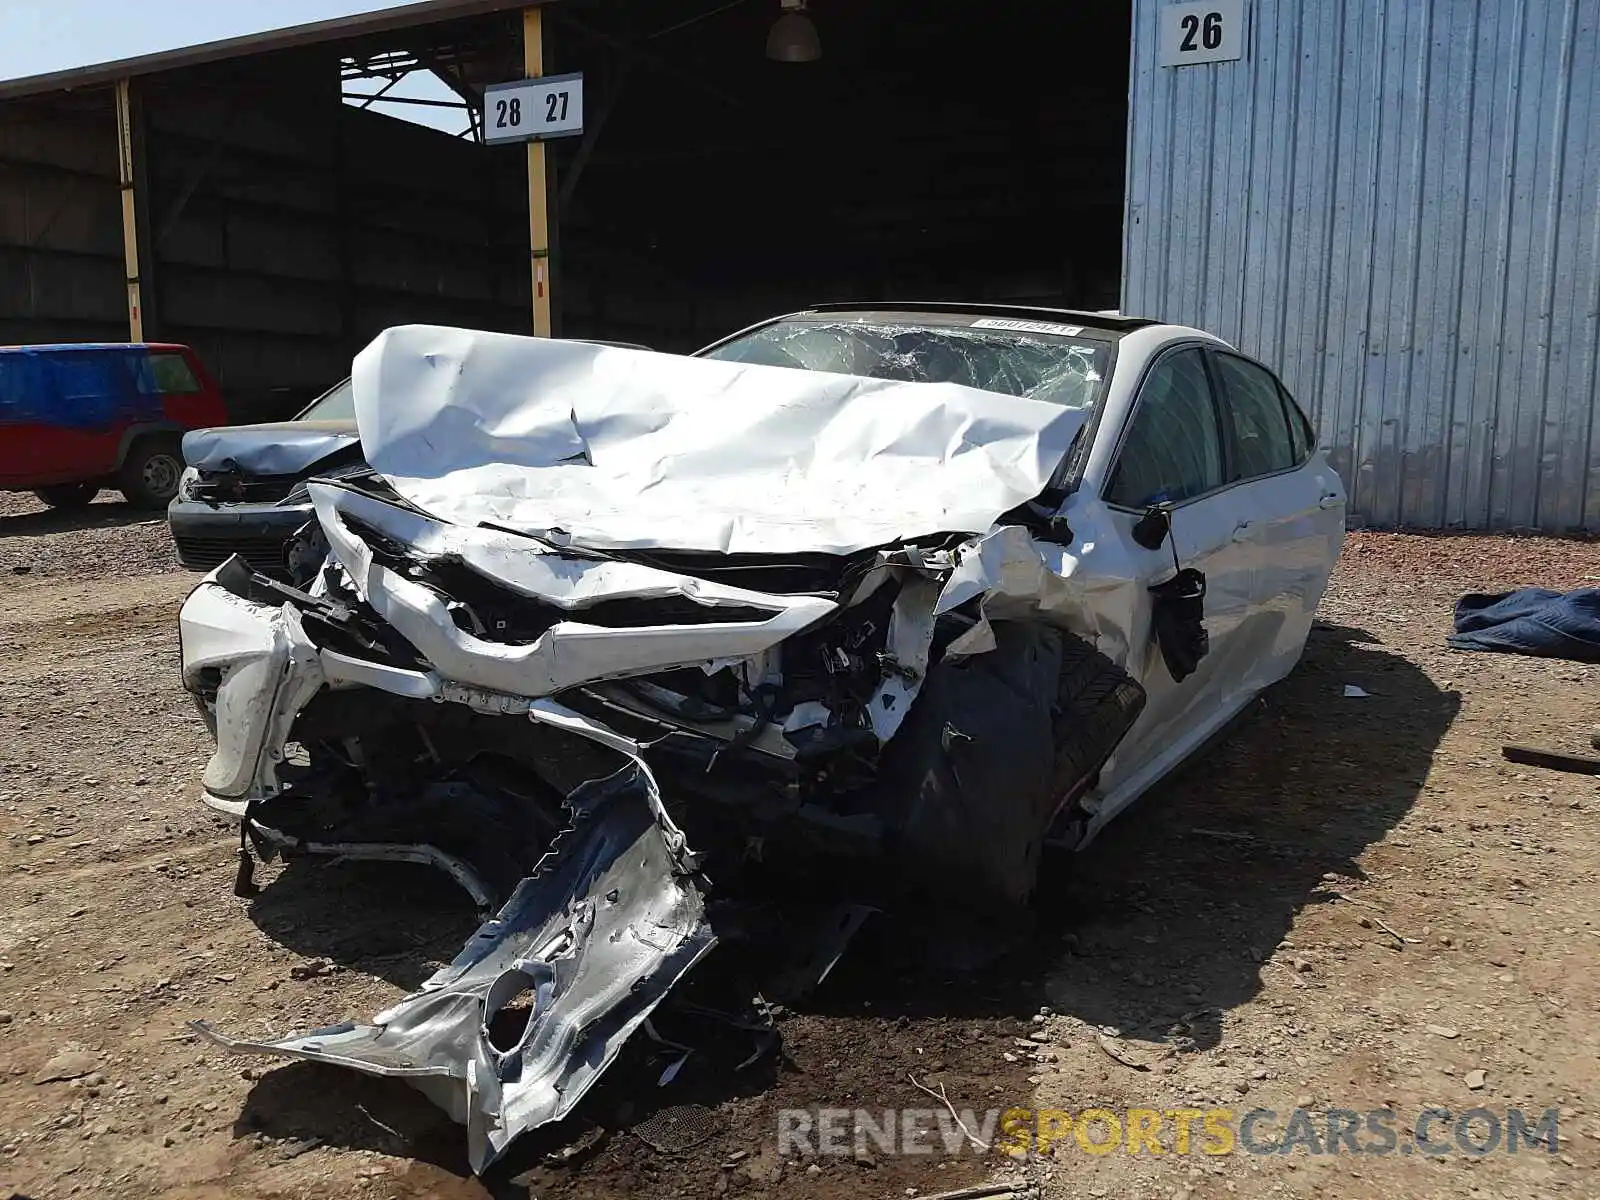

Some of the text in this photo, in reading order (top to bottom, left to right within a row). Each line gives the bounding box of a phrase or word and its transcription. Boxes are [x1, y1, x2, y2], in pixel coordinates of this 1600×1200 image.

[1180, 12, 1223, 52] 26
[496, 92, 569, 128] 28 27
